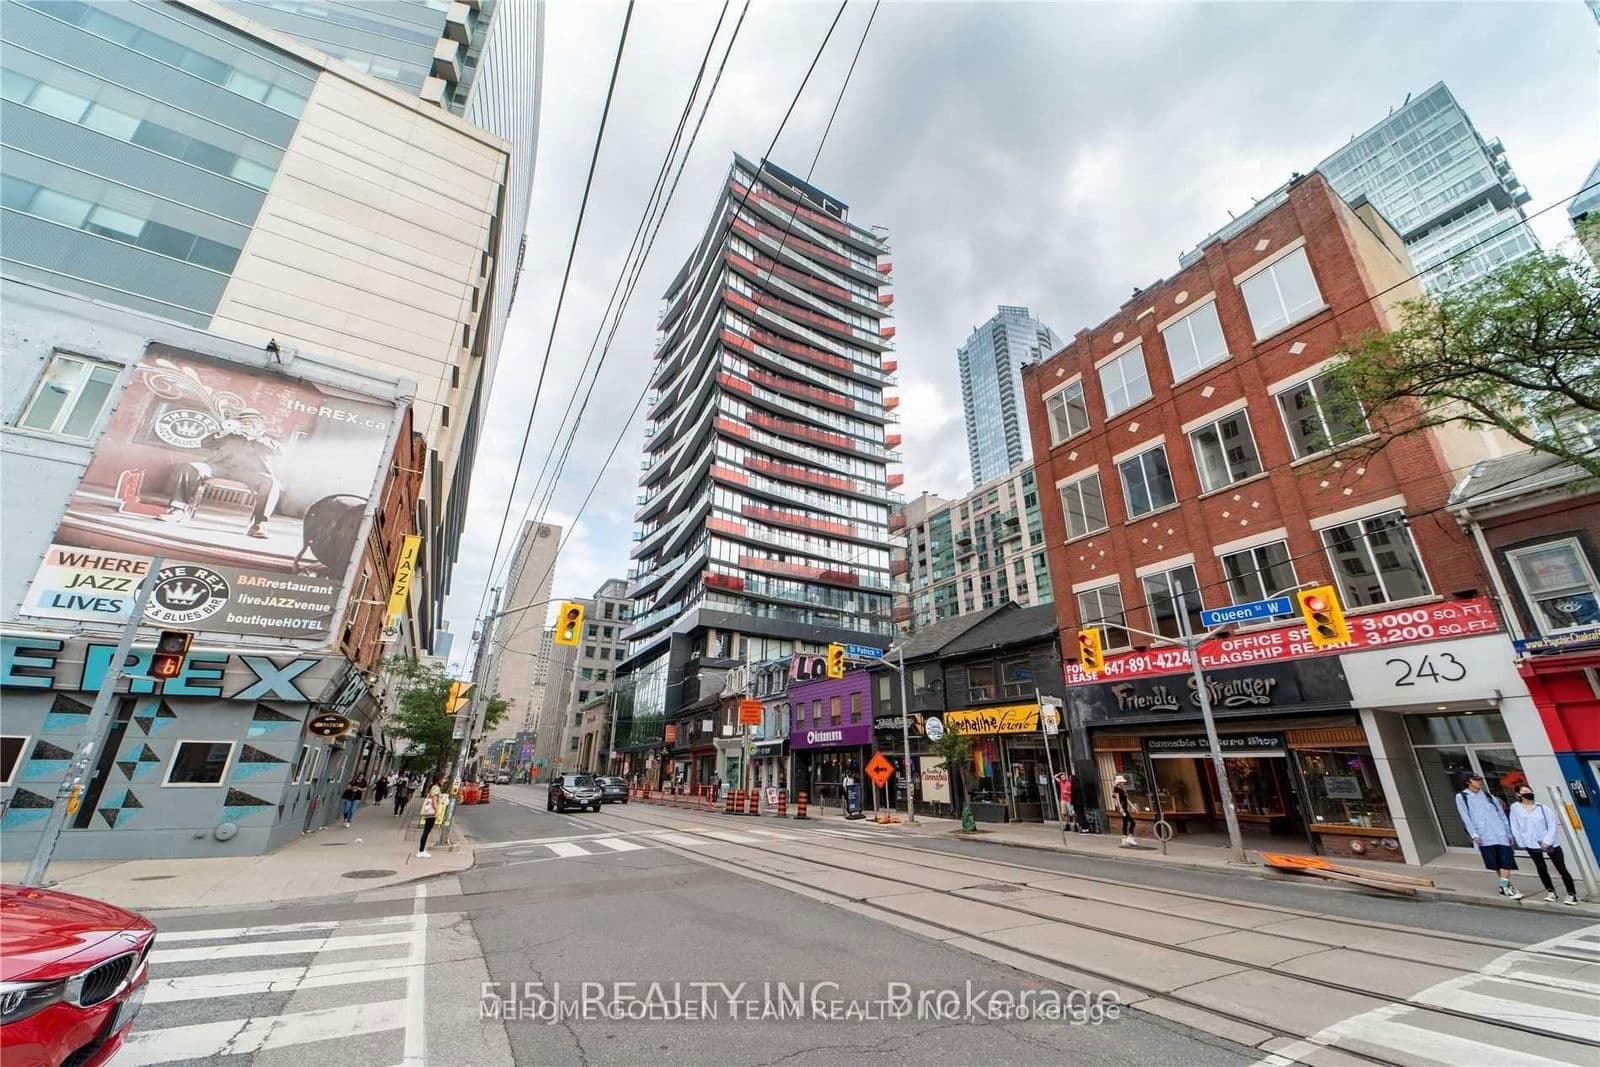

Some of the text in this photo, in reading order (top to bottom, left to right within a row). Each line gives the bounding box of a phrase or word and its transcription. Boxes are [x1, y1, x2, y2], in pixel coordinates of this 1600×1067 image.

[286, 399, 387, 431] theREX.ca
[58, 551, 149, 575] WHERE
[394, 548, 413, 596] JAZZ
[65, 573, 132, 592] JAZZ
[155, 567, 226, 592] HE REX
[237, 575, 334, 596] BARrestaurant
[52, 593, 123, 613] LIVES
[162, 611, 202, 622] BLUES
[202, 598, 222, 615] BAR
[238, 593, 331, 613] liveJAZZvenue
[1211, 607, 1253, 622] Queen
[1266, 602, 1279, 613] W
[226, 612, 324, 631] boutiqueHOTEL
[1221, 633, 1283, 652] OFFICE
[1288, 622, 1354, 641] SPE
[1361, 610, 1429, 631] 3,000
[1201, 646, 1284, 665] FLAGSHIP
[1289, 640, 1360, 654] REAIL
[1366, 623, 1434, 645] 3,200
[80, 642, 323, 702] REX
[1104, 650, 1192, 676] 647-891-4224
[1385, 653, 1466, 687] 243
[1067, 671, 1099, 684] LEASE
[1112, 674, 1277, 711] Friendly Stranger
[1148, 735, 1279, 748] Cannabis Cuture Shop
